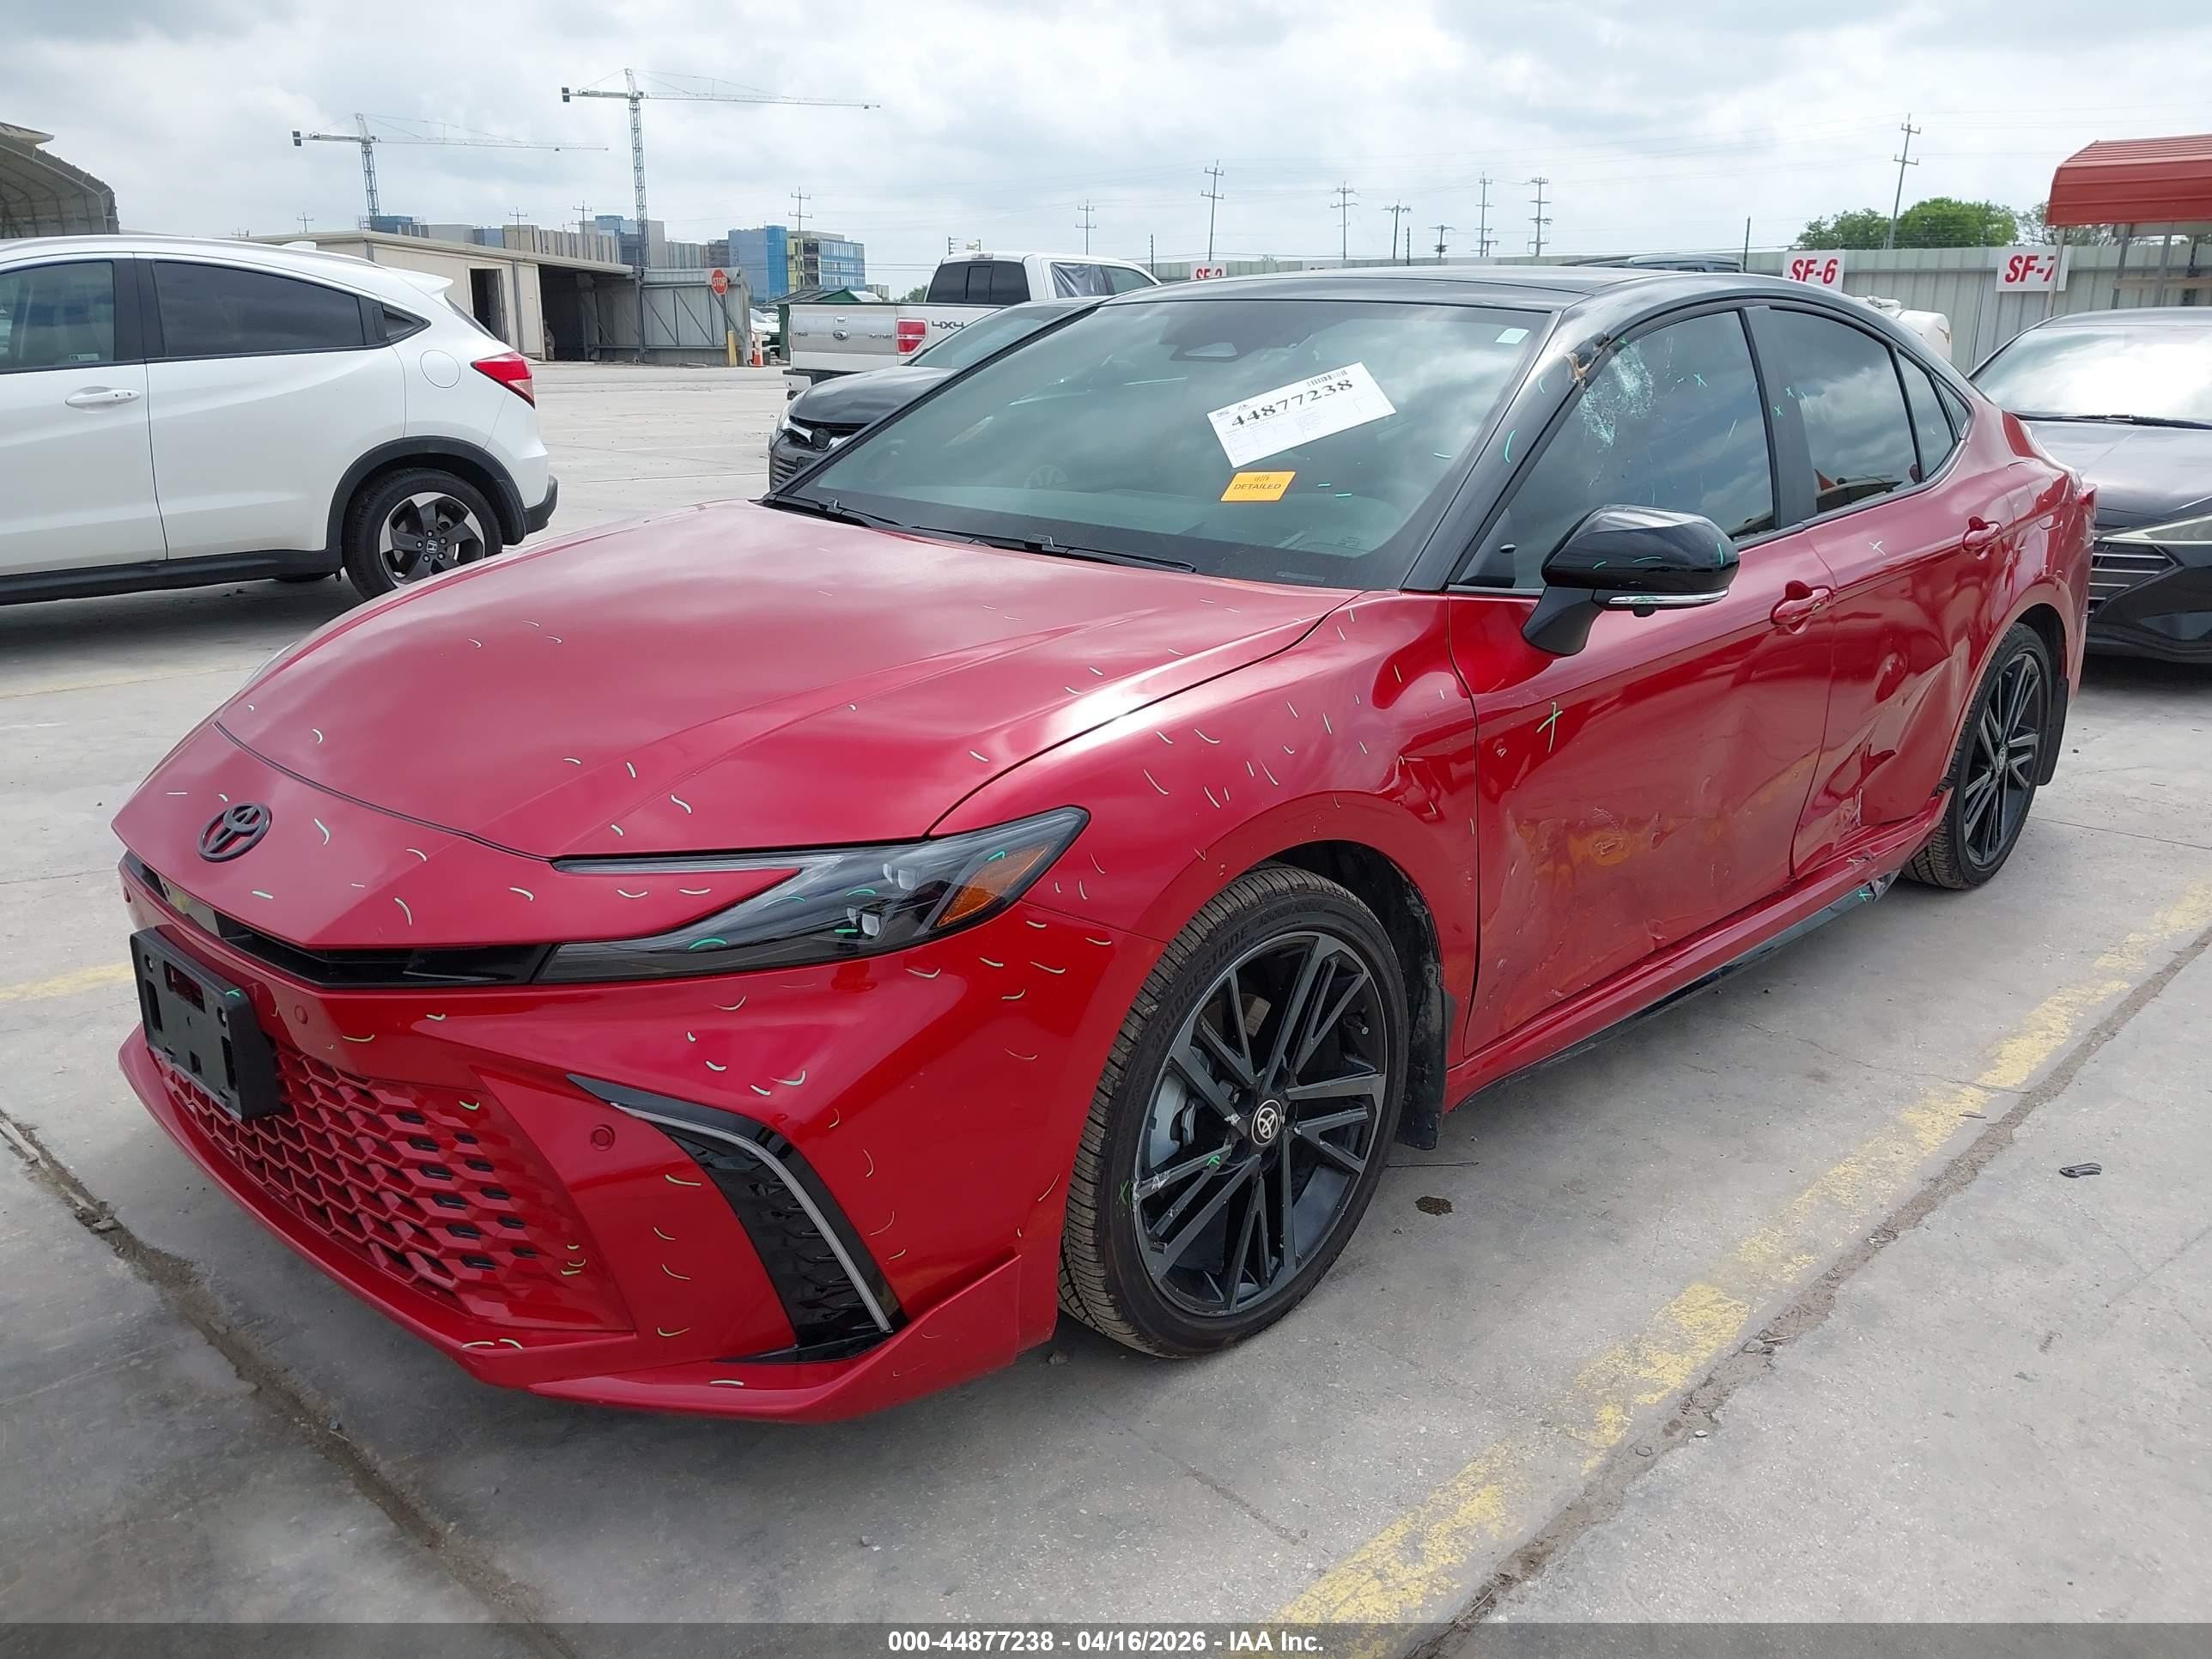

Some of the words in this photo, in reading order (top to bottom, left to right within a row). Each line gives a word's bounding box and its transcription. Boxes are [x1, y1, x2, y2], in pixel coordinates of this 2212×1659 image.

[713, 276, 727, 287] STOP
[1789, 258, 1838, 284] SF-6
[1231, 380, 1353, 427] 44877238
